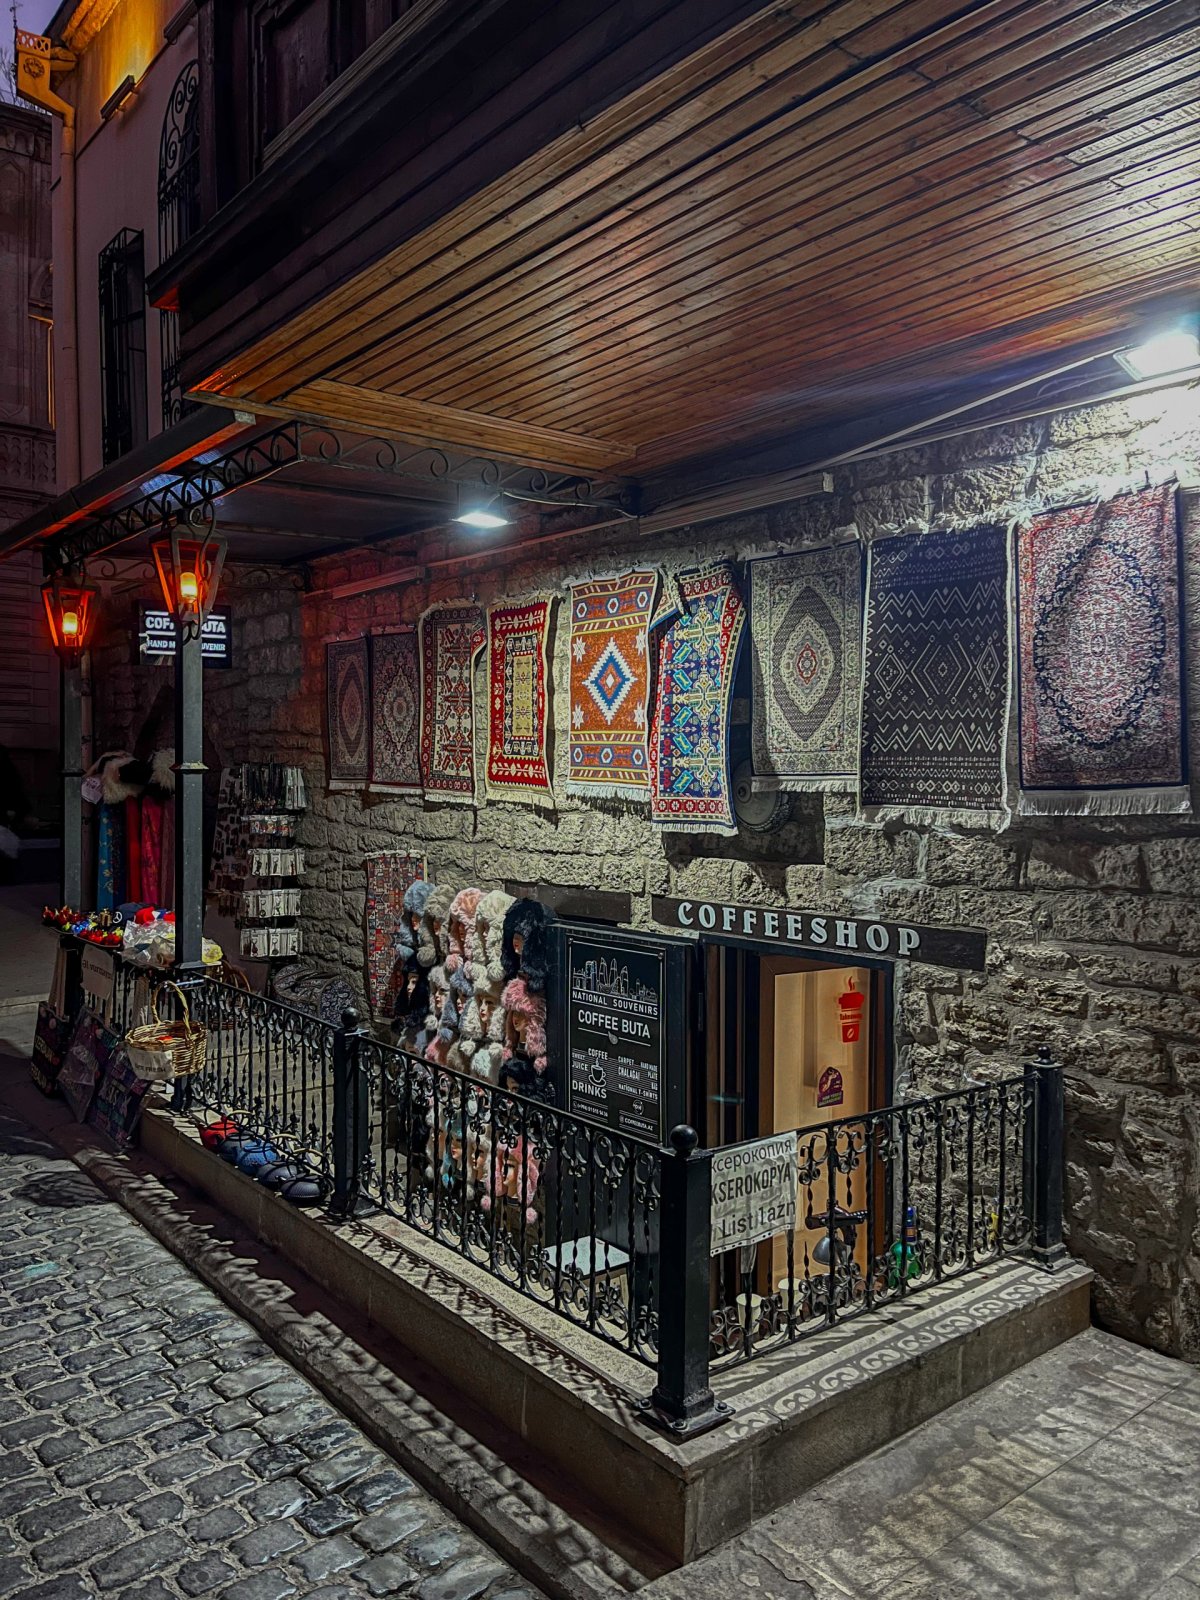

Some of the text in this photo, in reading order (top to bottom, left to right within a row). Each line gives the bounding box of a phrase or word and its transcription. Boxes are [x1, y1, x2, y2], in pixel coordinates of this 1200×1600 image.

[202, 620, 226, 633] UTA
[201, 642, 226, 651] UVENIR
[678, 901, 921, 956] COFFEESHOP
[572, 990, 658, 1016] NATIONAL SOUVENIRS
[578, 1009, 651, 1039] COFFEE BUTA
[588, 1047, 608, 1060] COFFEE
[618, 1055, 635, 1066] CARPET
[572, 1060, 588, 1071] JUICE
[572, 1080, 607, 1099] DRINKS
[711, 1162, 791, 1205] KSEROKOPYA
[722, 1212, 754, 1238] List
